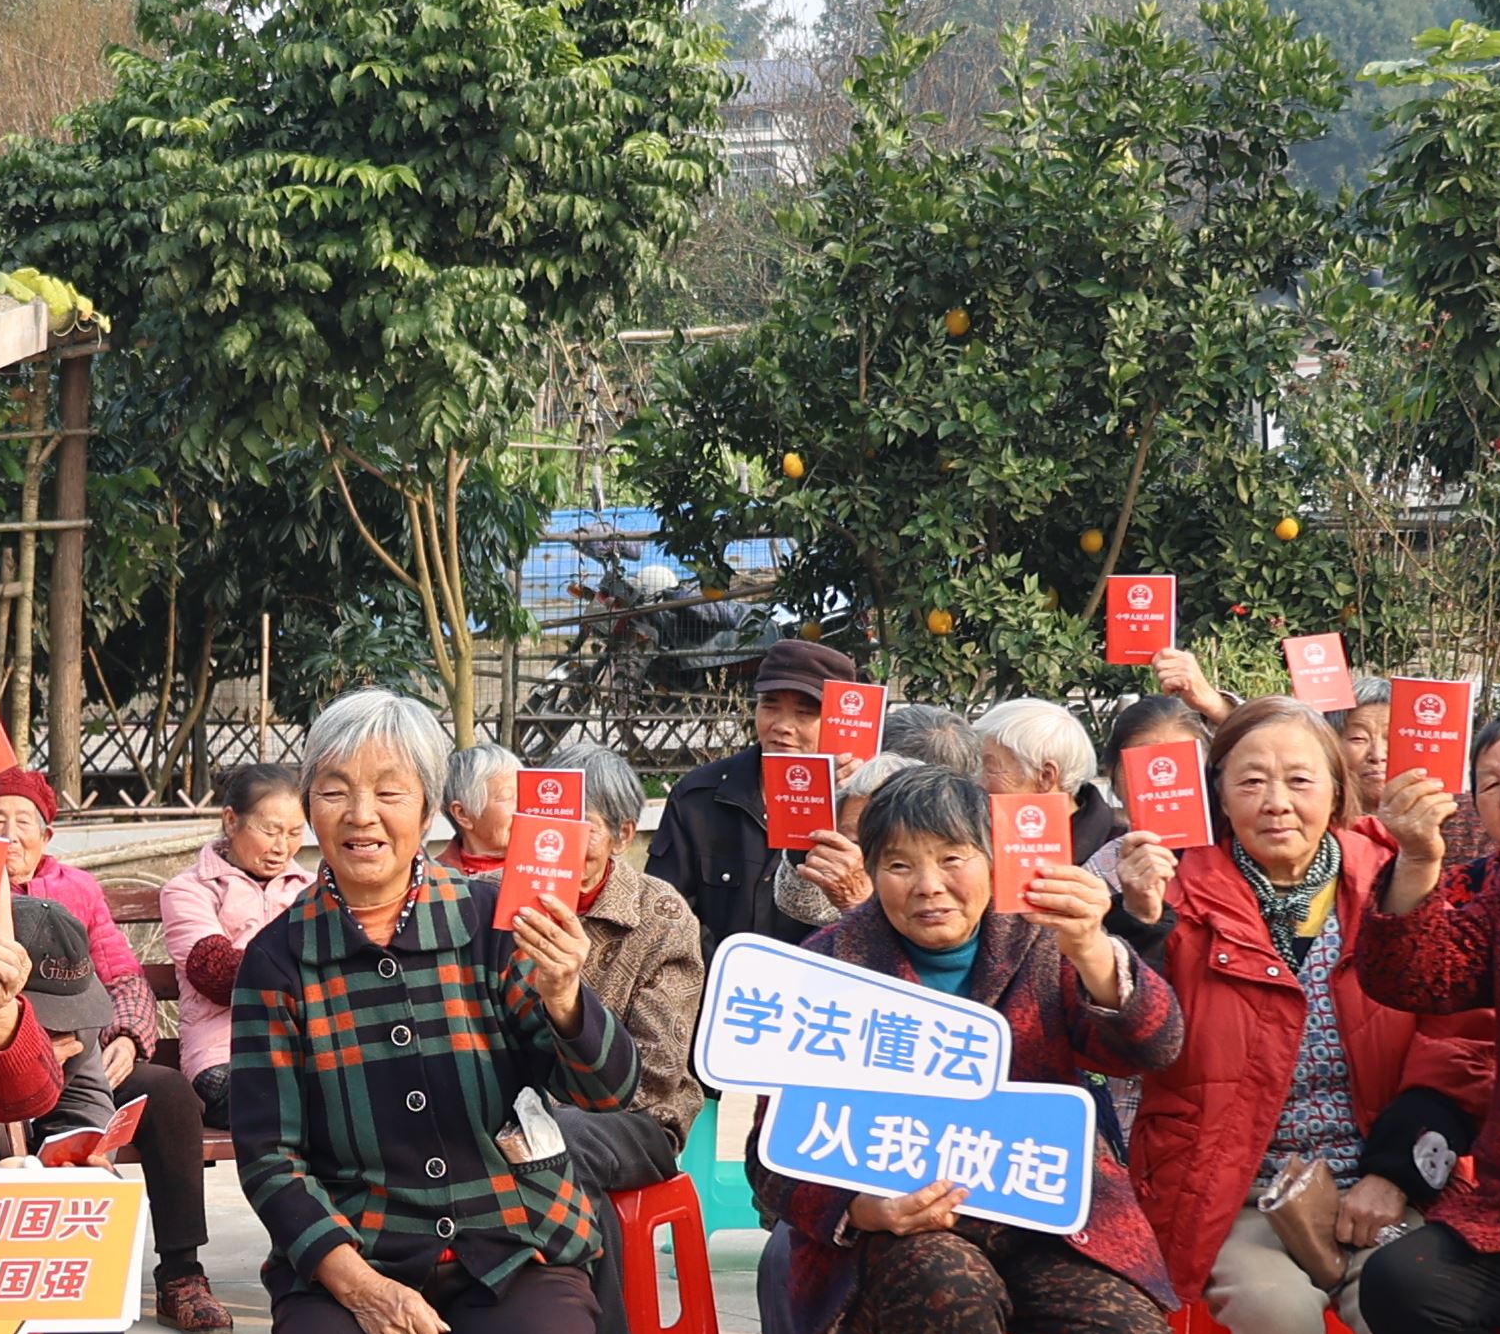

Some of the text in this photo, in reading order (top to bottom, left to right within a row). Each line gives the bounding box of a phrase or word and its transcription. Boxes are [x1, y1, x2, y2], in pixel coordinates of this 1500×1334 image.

[723, 986, 989, 1086] 学法懂法
[797, 1101, 1069, 1204] 从我做起
